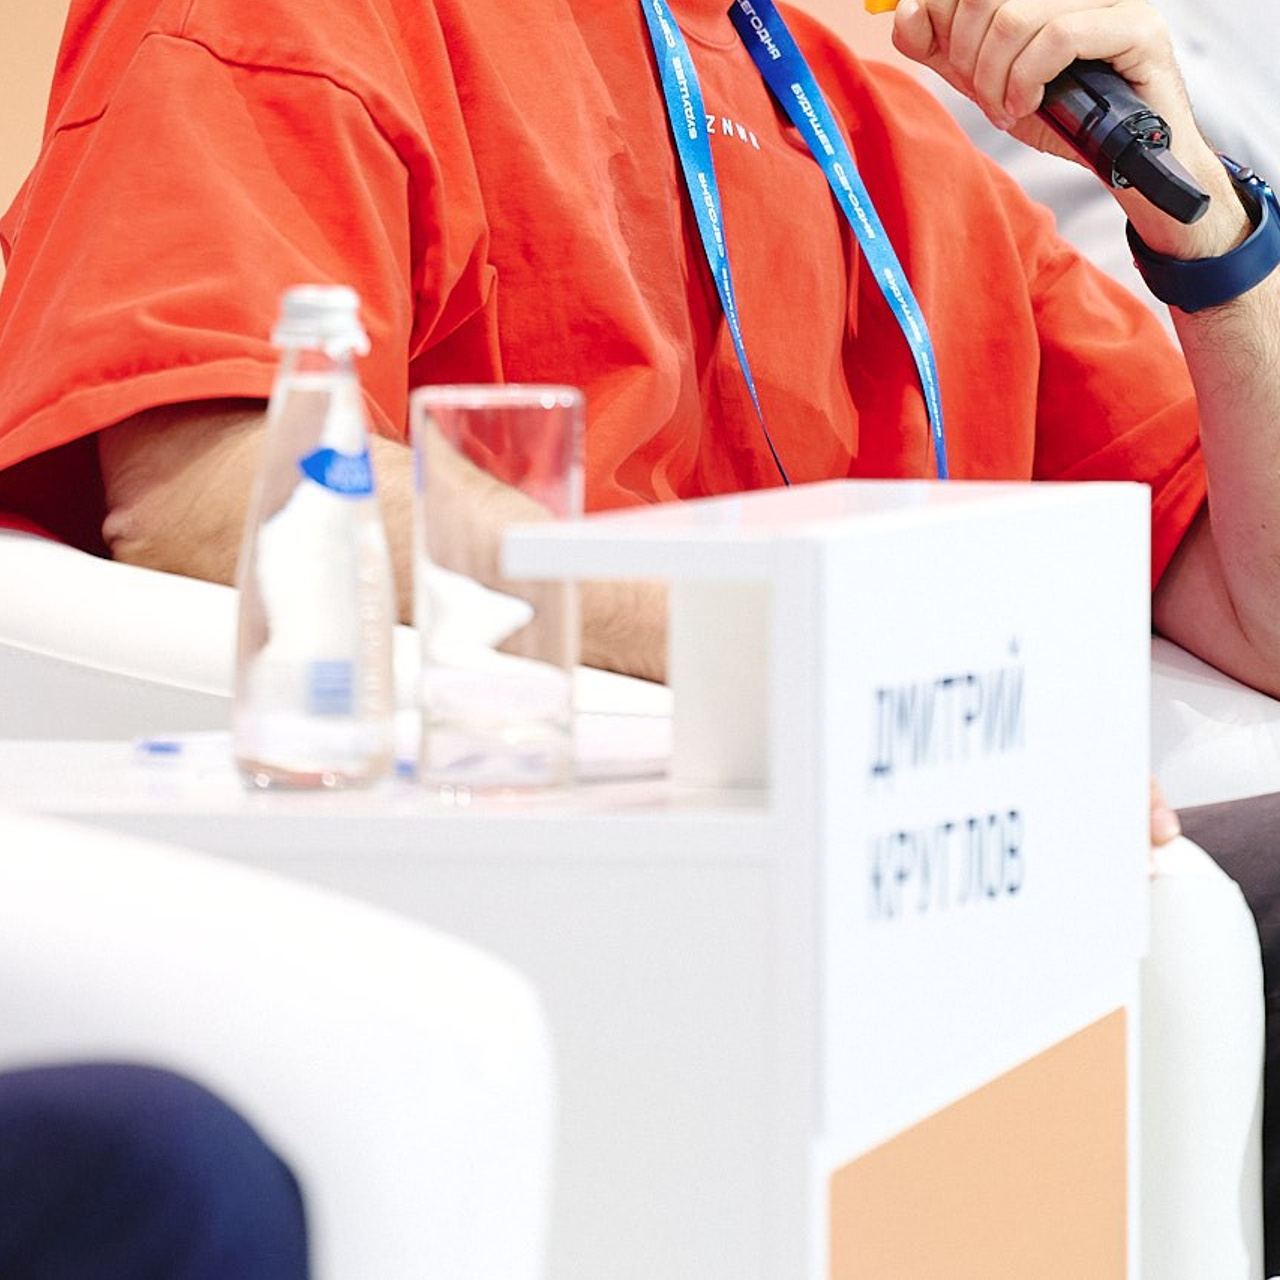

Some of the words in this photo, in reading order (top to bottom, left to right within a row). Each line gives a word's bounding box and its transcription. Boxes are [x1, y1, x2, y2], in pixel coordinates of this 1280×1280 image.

[672, 56, 698, 140] БУДУЩЕЕ
[791, 82, 835, 157] БУДУЩЕЕ
[832, 161, 876, 240] СЕГОДНЯ
[868, 638, 1027, 780] ДМИТРИЙ
[867, 808, 1025, 920] КРУГЛОВ
